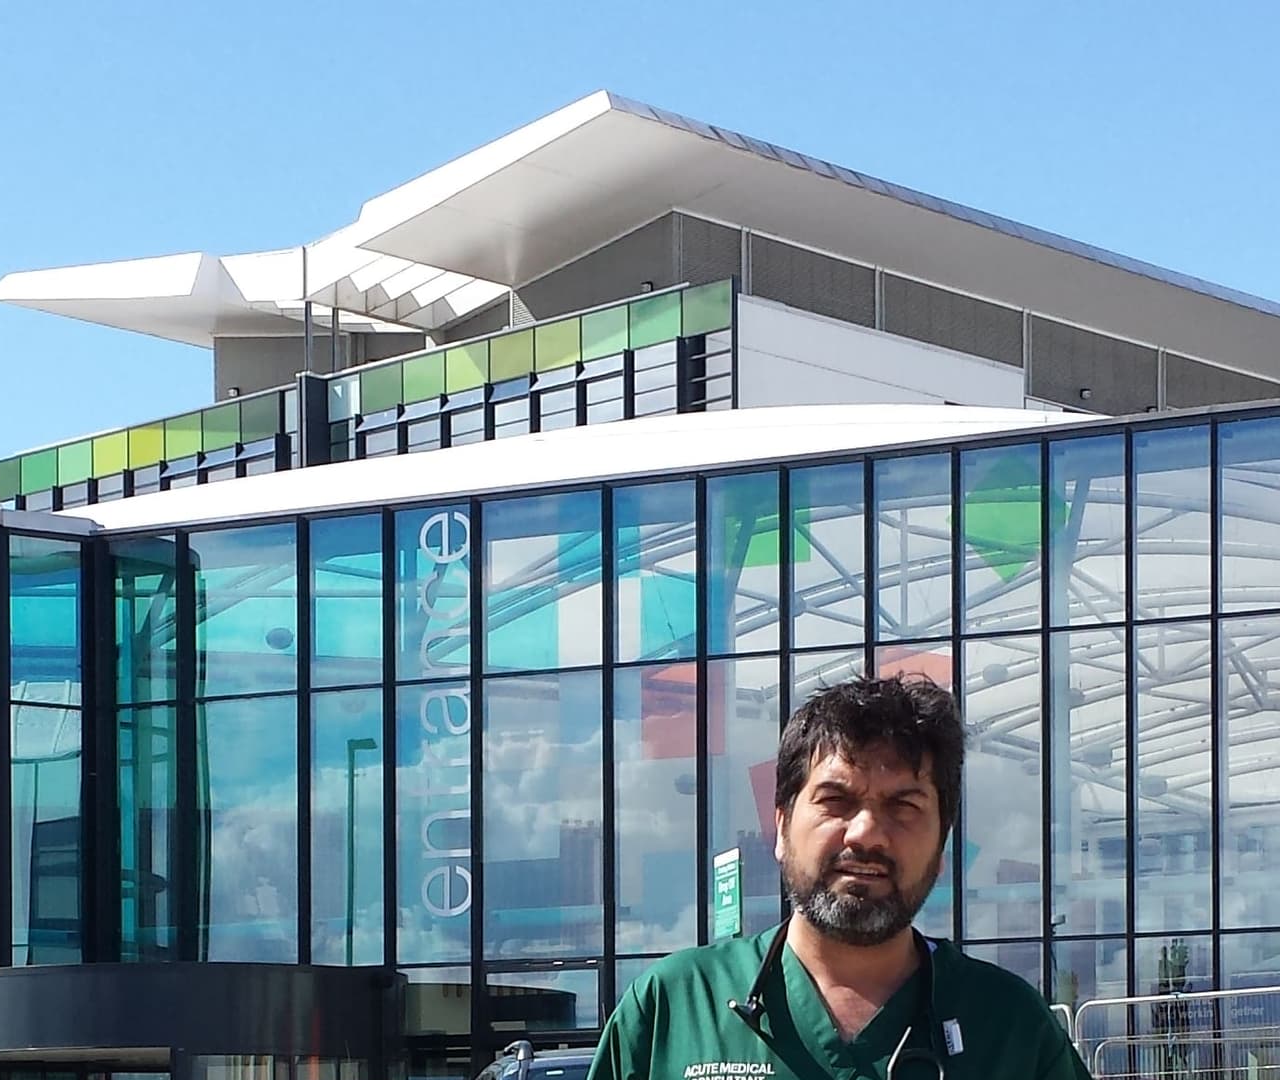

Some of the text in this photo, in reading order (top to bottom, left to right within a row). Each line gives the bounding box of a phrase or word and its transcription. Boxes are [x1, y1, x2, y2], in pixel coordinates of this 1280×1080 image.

[419, 511, 471, 918] entrance
[684, 1062, 775, 1079] ACUTE MEDICAL
